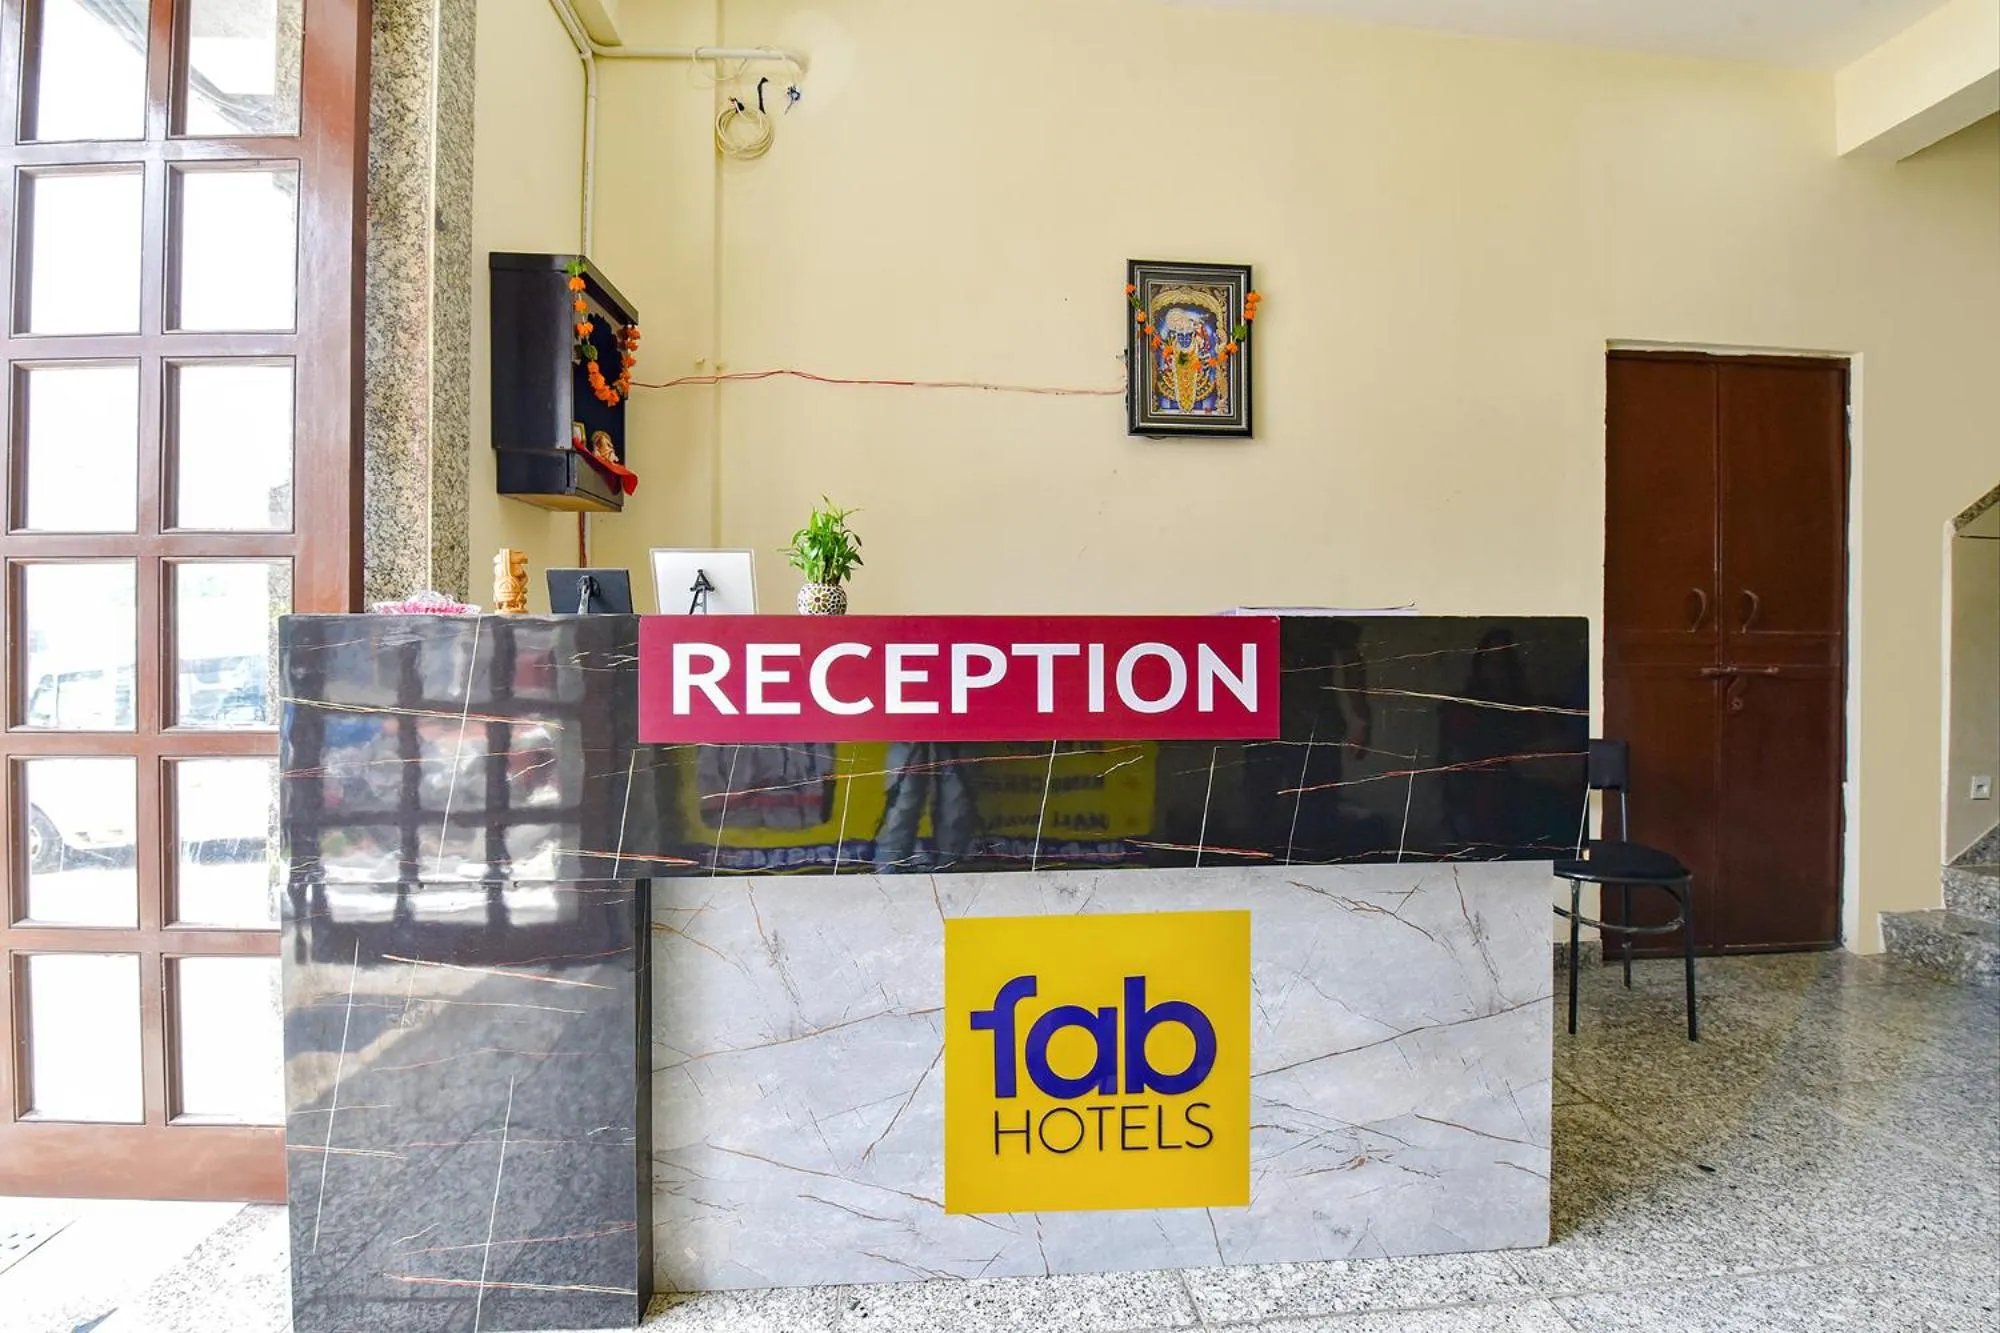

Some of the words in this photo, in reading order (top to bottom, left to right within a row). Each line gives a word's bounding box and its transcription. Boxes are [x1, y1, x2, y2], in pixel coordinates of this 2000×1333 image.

[672, 643, 1258, 715] RECEPTION
[970, 975, 1217, 1099] fab
[994, 1103, 1213, 1155] HOTELS
